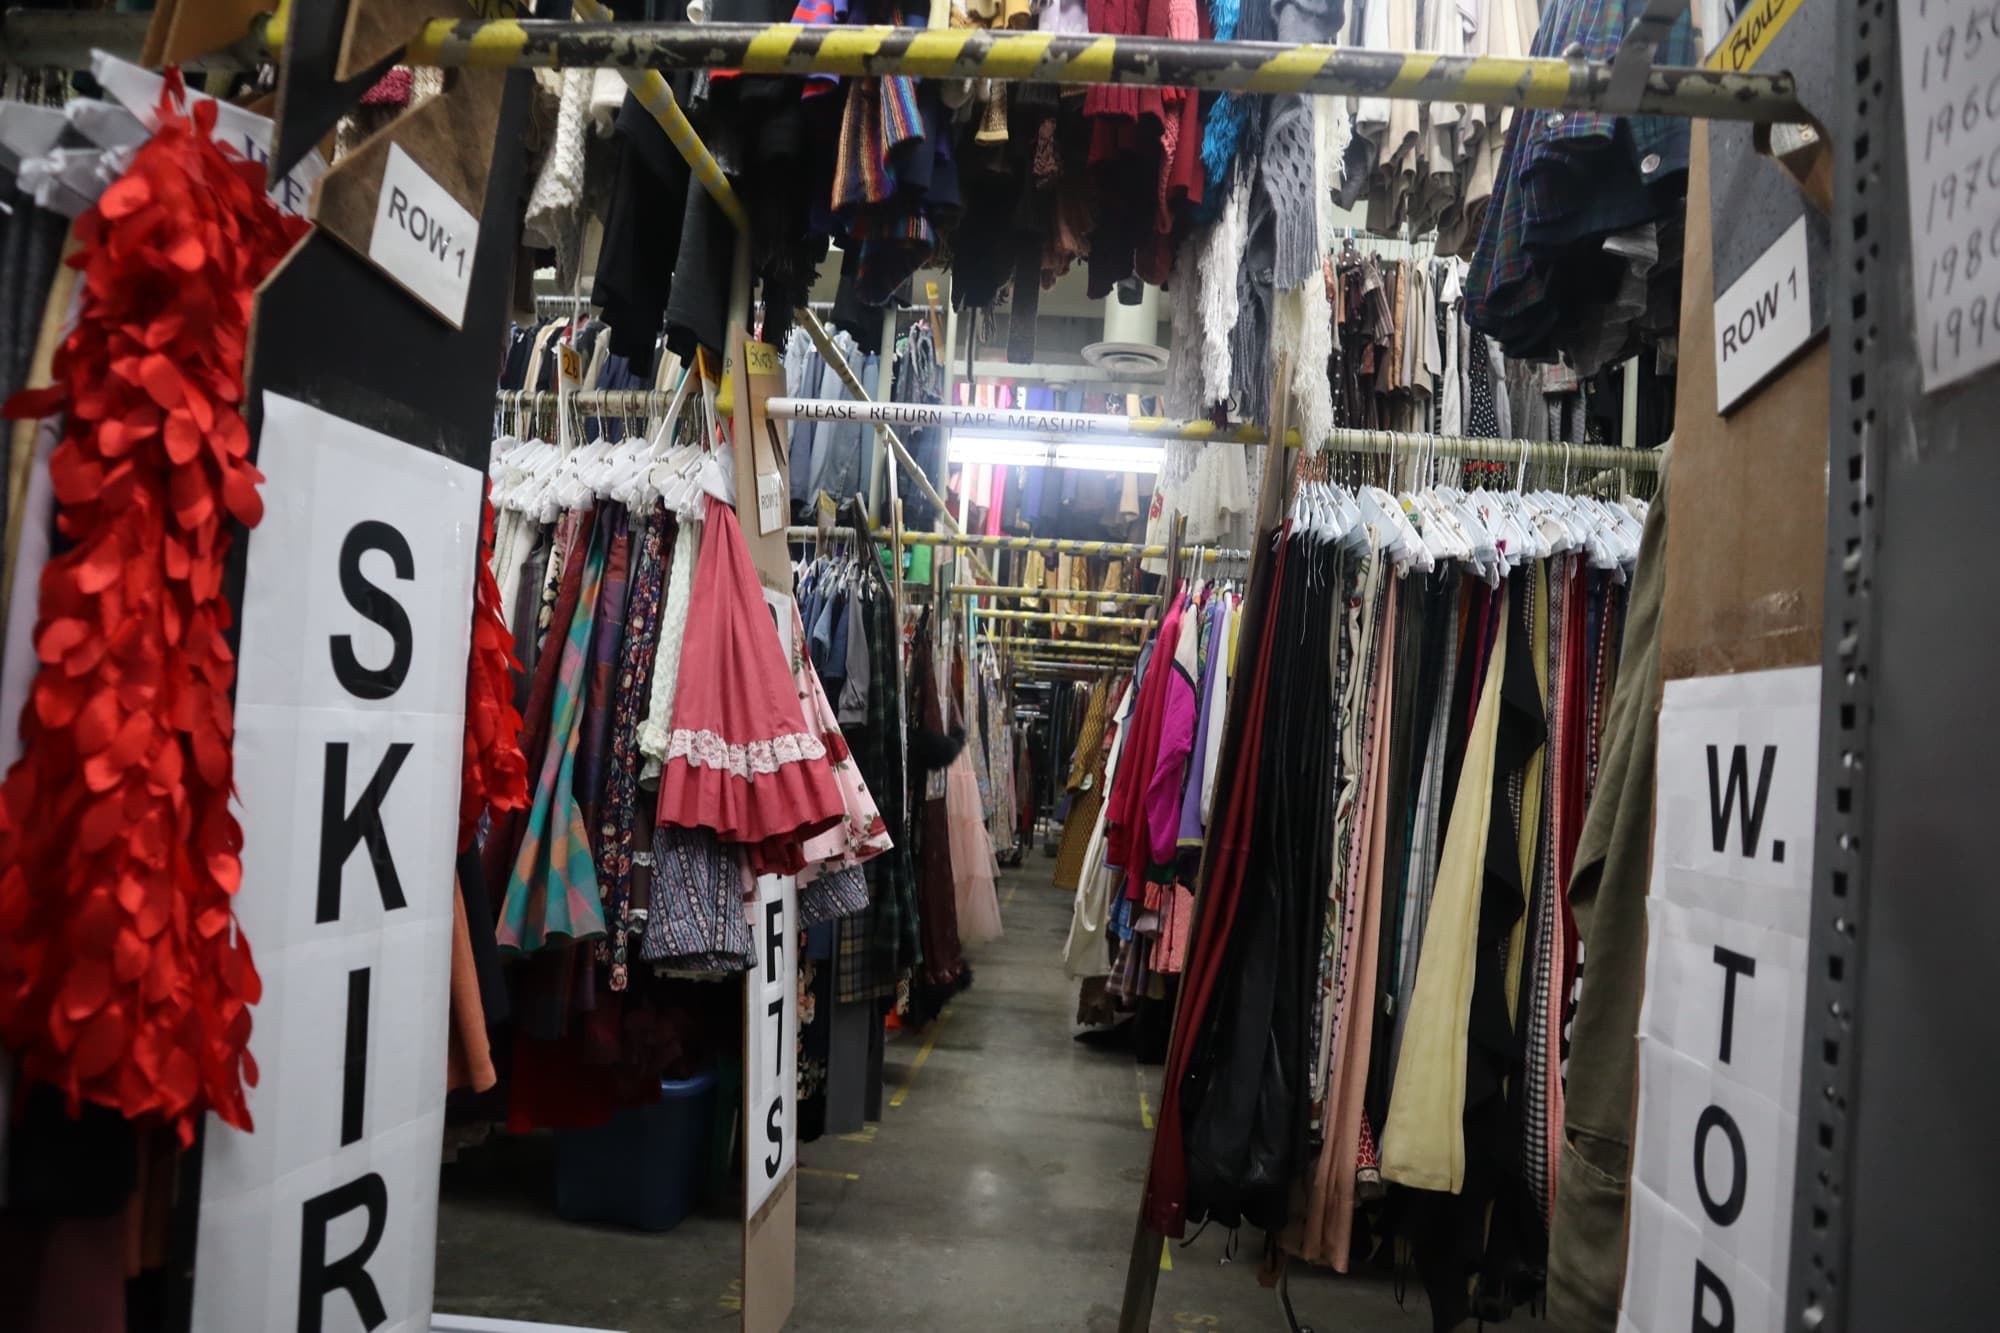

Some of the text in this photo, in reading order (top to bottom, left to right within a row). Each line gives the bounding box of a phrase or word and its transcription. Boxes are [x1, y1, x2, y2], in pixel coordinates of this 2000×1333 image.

[388, 184, 466, 279] ROW 1
[1722, 266, 1797, 363] ROW 1
[794, 403, 1097, 433] PLEASE RETURN TAPE MEASURE
